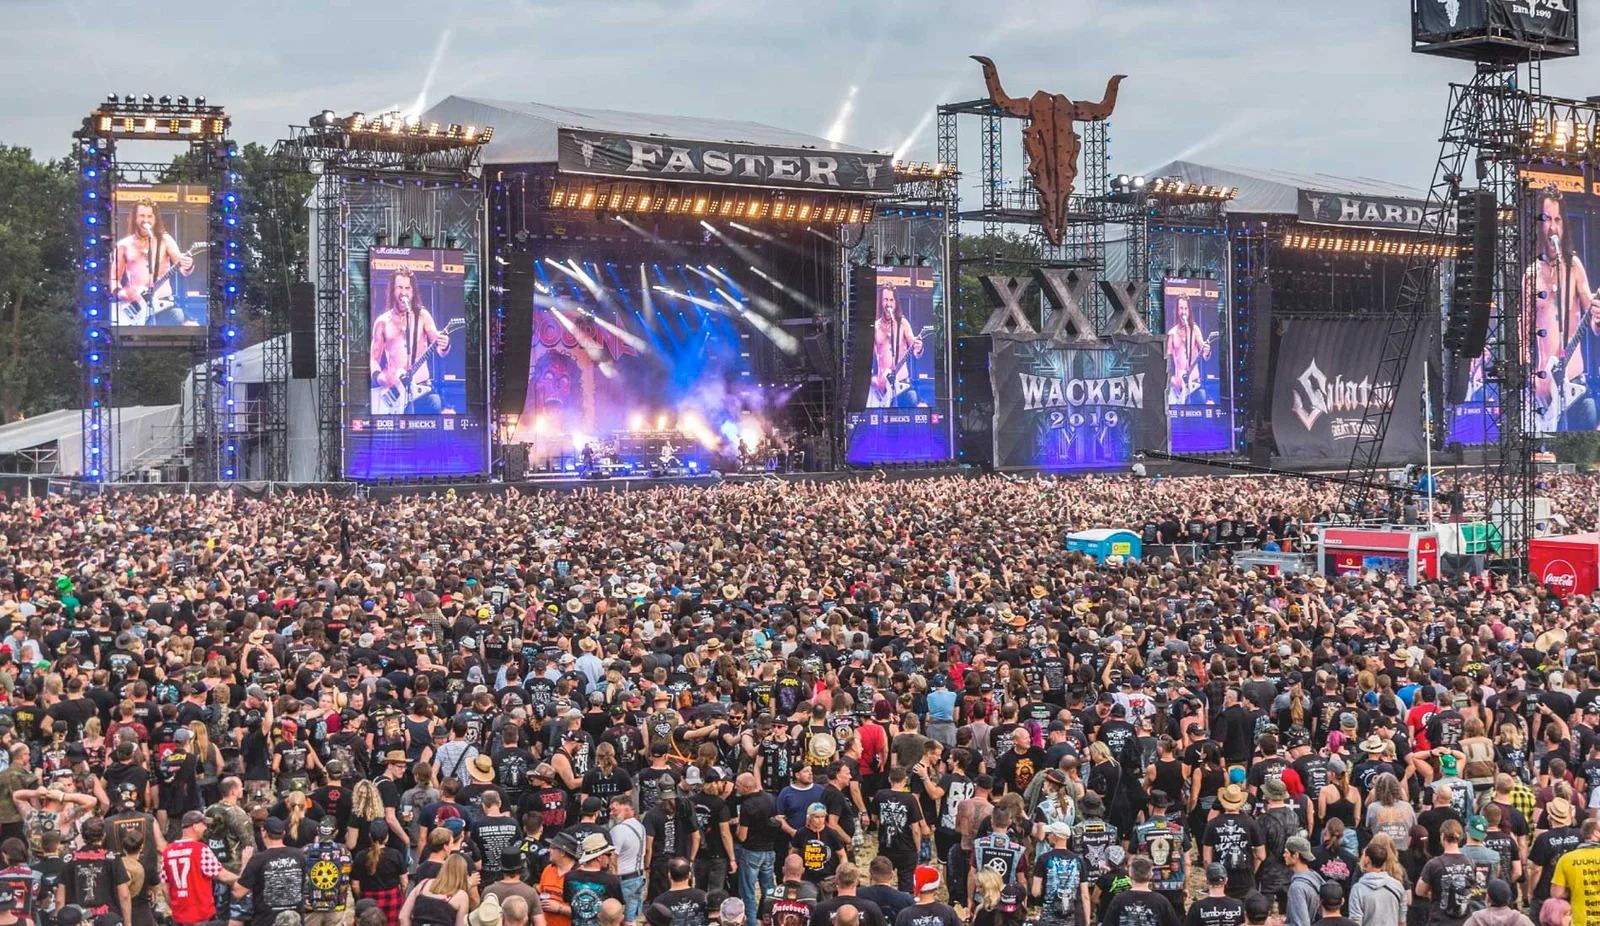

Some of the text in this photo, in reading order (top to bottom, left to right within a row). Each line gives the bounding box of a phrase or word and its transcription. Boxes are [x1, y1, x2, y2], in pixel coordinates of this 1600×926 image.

[625, 139, 840, 187] FASTER
[1019, 373, 1145, 410] WACKEN
[1050, 411, 1118, 429] 2019
[1545, 572, 1575, 587] Coca-Cola
[168, 857, 190, 889] 17
